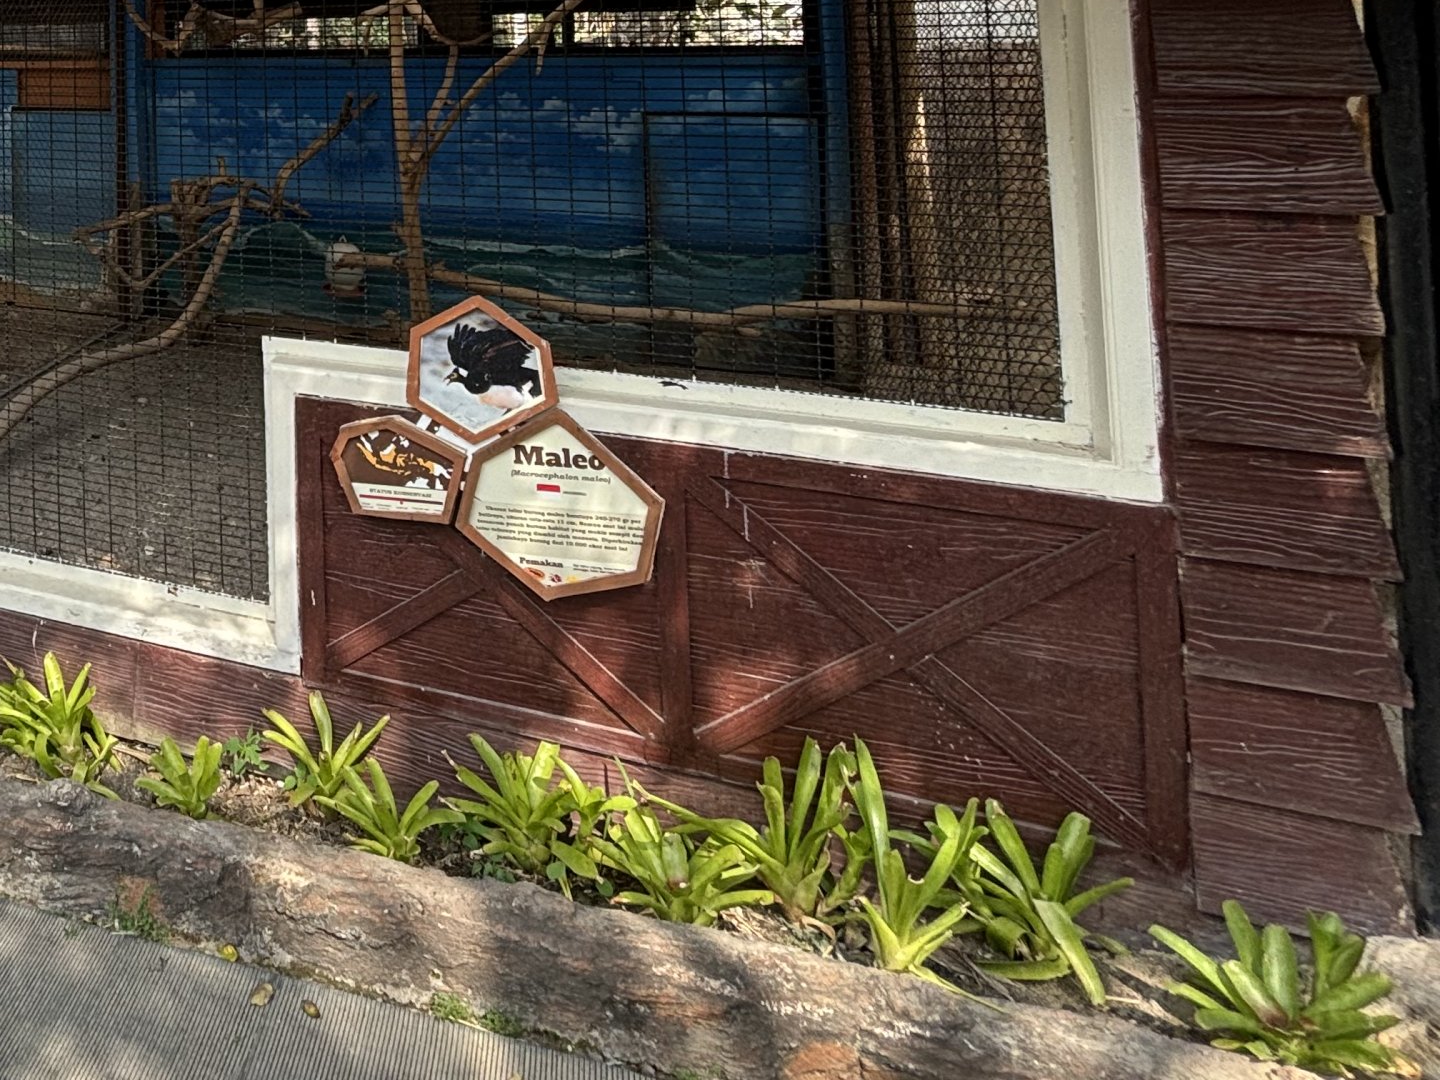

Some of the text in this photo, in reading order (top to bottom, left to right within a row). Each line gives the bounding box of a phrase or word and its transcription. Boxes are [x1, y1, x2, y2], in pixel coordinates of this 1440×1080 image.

[513, 444, 606, 471] Maleo
[510, 469, 611, 484] (Macrocephalon maleo)
[519, 556, 564, 568] Pemakan
